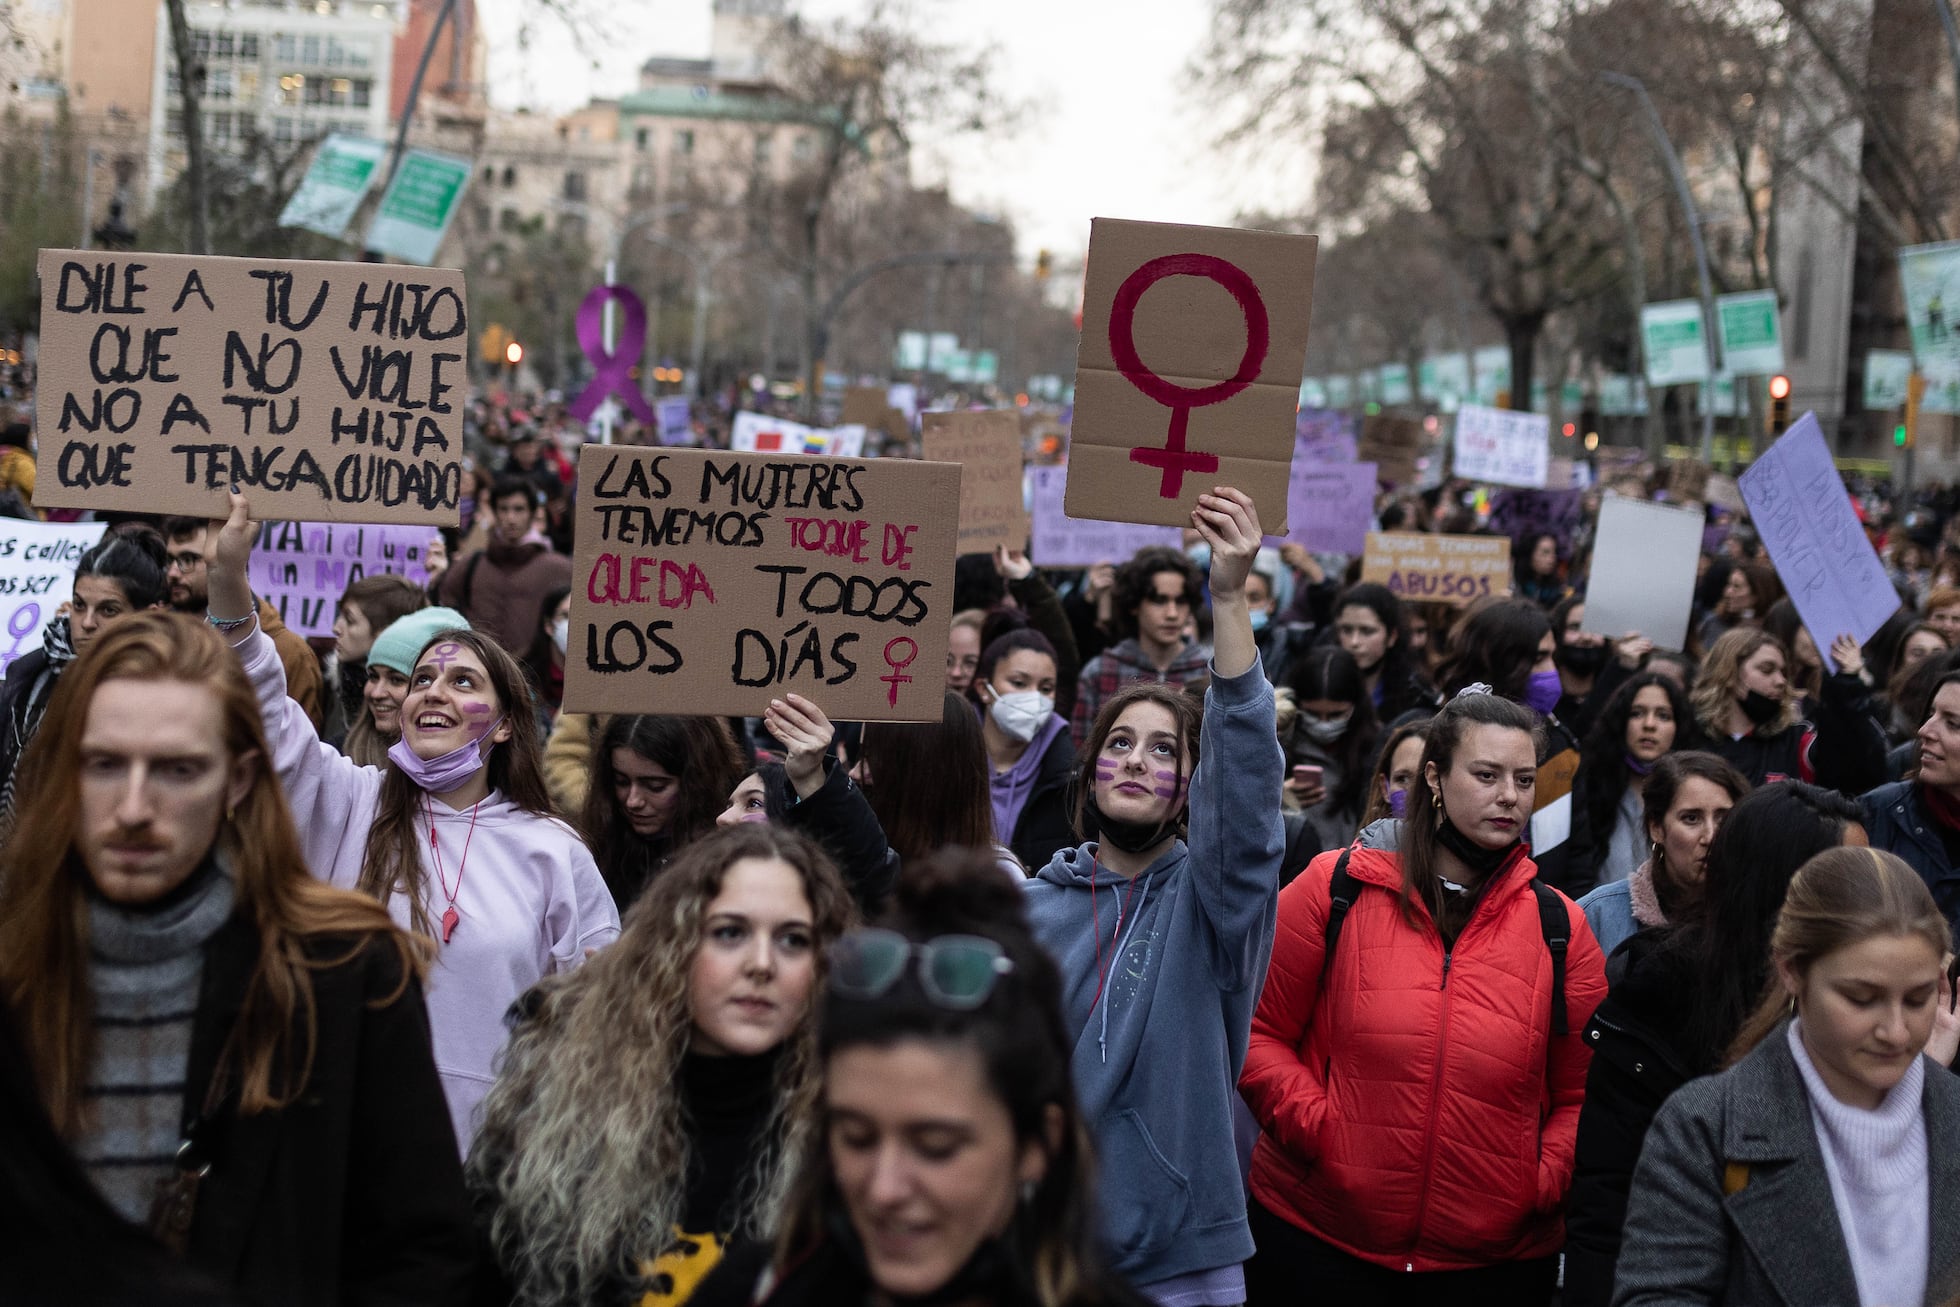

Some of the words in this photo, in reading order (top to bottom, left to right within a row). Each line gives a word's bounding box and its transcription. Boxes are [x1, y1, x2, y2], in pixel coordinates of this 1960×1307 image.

[56, 261, 149, 314] DILE
[172, 269, 214, 312] A
[249, 269, 330, 332] TU
[348, 279, 467, 341] HIJO
[89, 322, 179, 384] QUE
[222, 330, 301, 394] NO
[329, 345, 461, 414] VIOLE
[57, 386, 142, 434] NO
[160, 393, 211, 436] A
[222, 394, 300, 435] TU
[331, 406, 449, 457] HIJA
[57, 440, 136, 490] QUE
[172, 443, 332, 501] TENGA
[334, 453, 461, 511] CUIDADO
[594, 454, 672, 499] LAS
[699, 460, 866, 512] MUJERES
[594, 504, 771, 548] TENEMOS
[785, 517, 871, 563] TOQUE
[882, 522, 919, 571] DE
[587, 553, 718, 610] QUEDA
[754, 564, 932, 626] TODOS
[1387, 570, 1492, 598] ABUSOS
[587, 620, 683, 675] LOS
[731, 620, 860, 688] DÍAS
